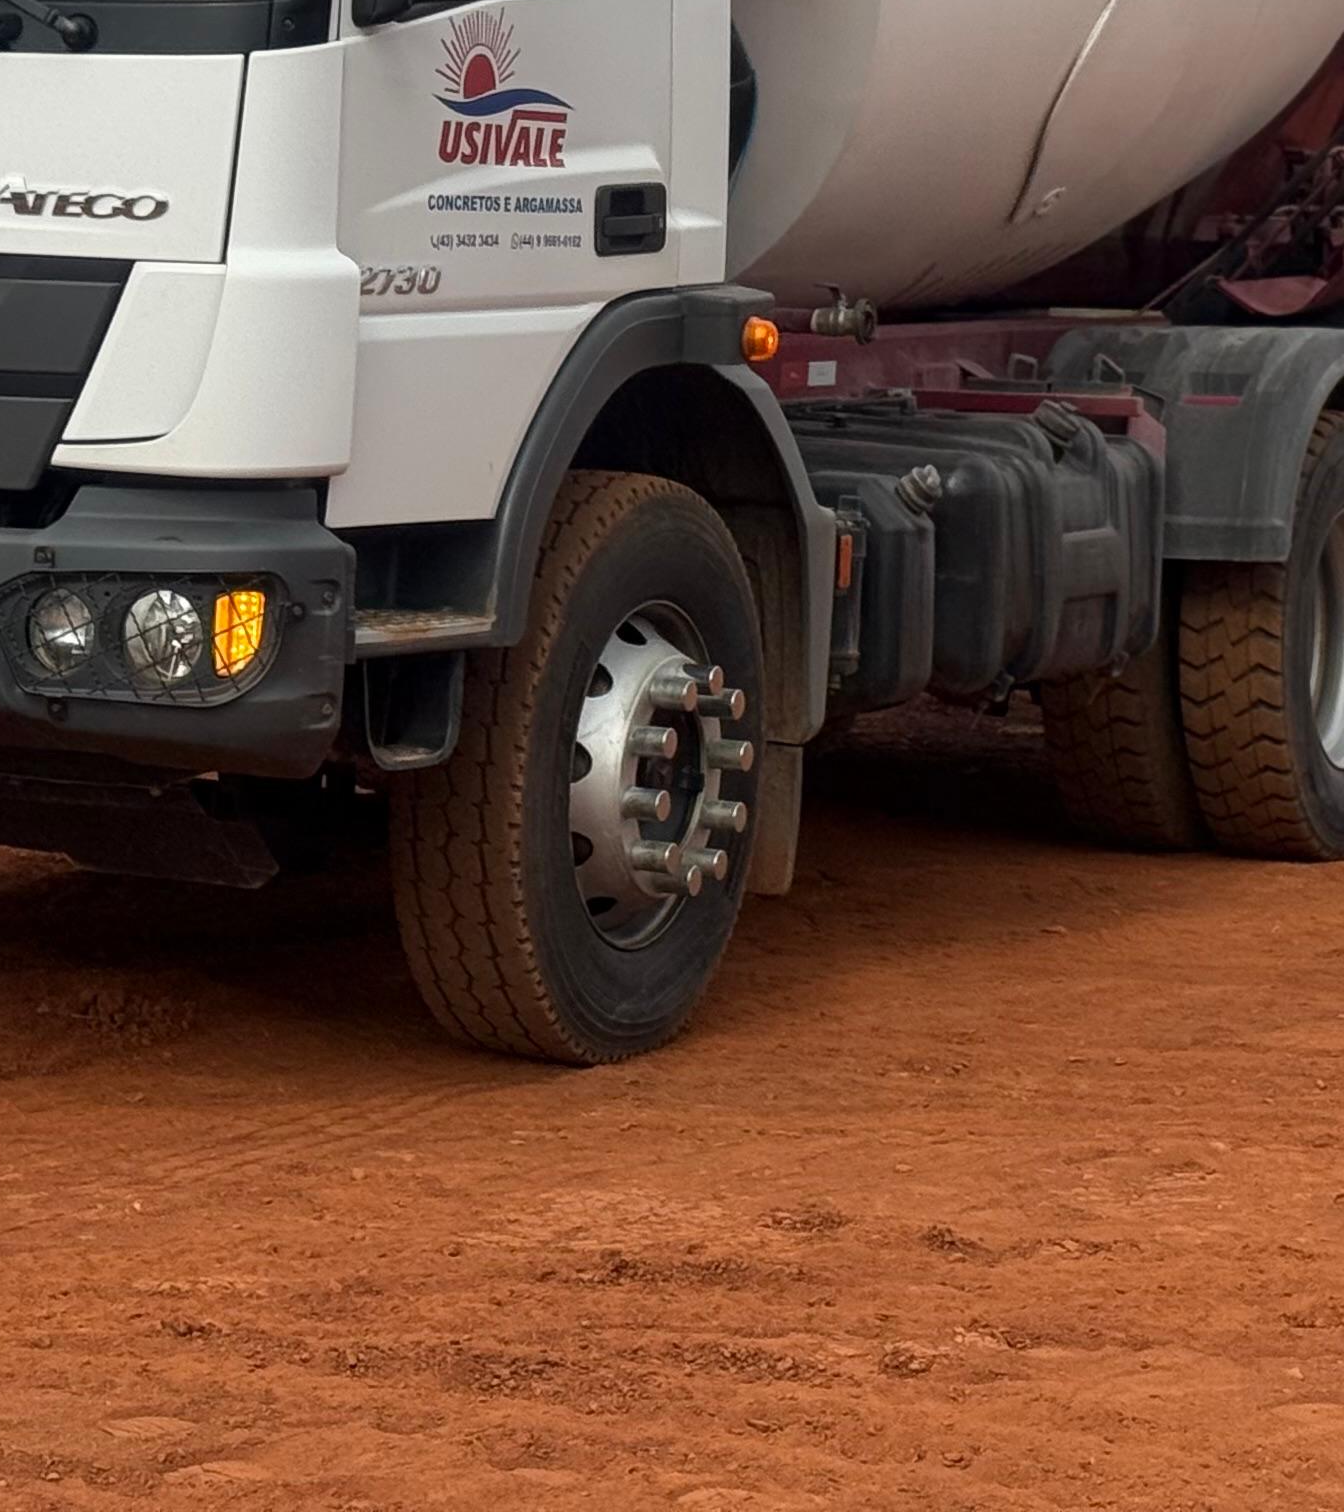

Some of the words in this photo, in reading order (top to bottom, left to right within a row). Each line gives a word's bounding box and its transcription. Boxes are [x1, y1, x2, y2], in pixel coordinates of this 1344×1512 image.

[438, 109, 568, 169] USIVALE
[427, 193, 501, 212] CONCRETOS
[504, 196, 512, 212] E
[514, 197, 584, 214] ARGAMASSA
[360, 266, 442, 296] 2730
